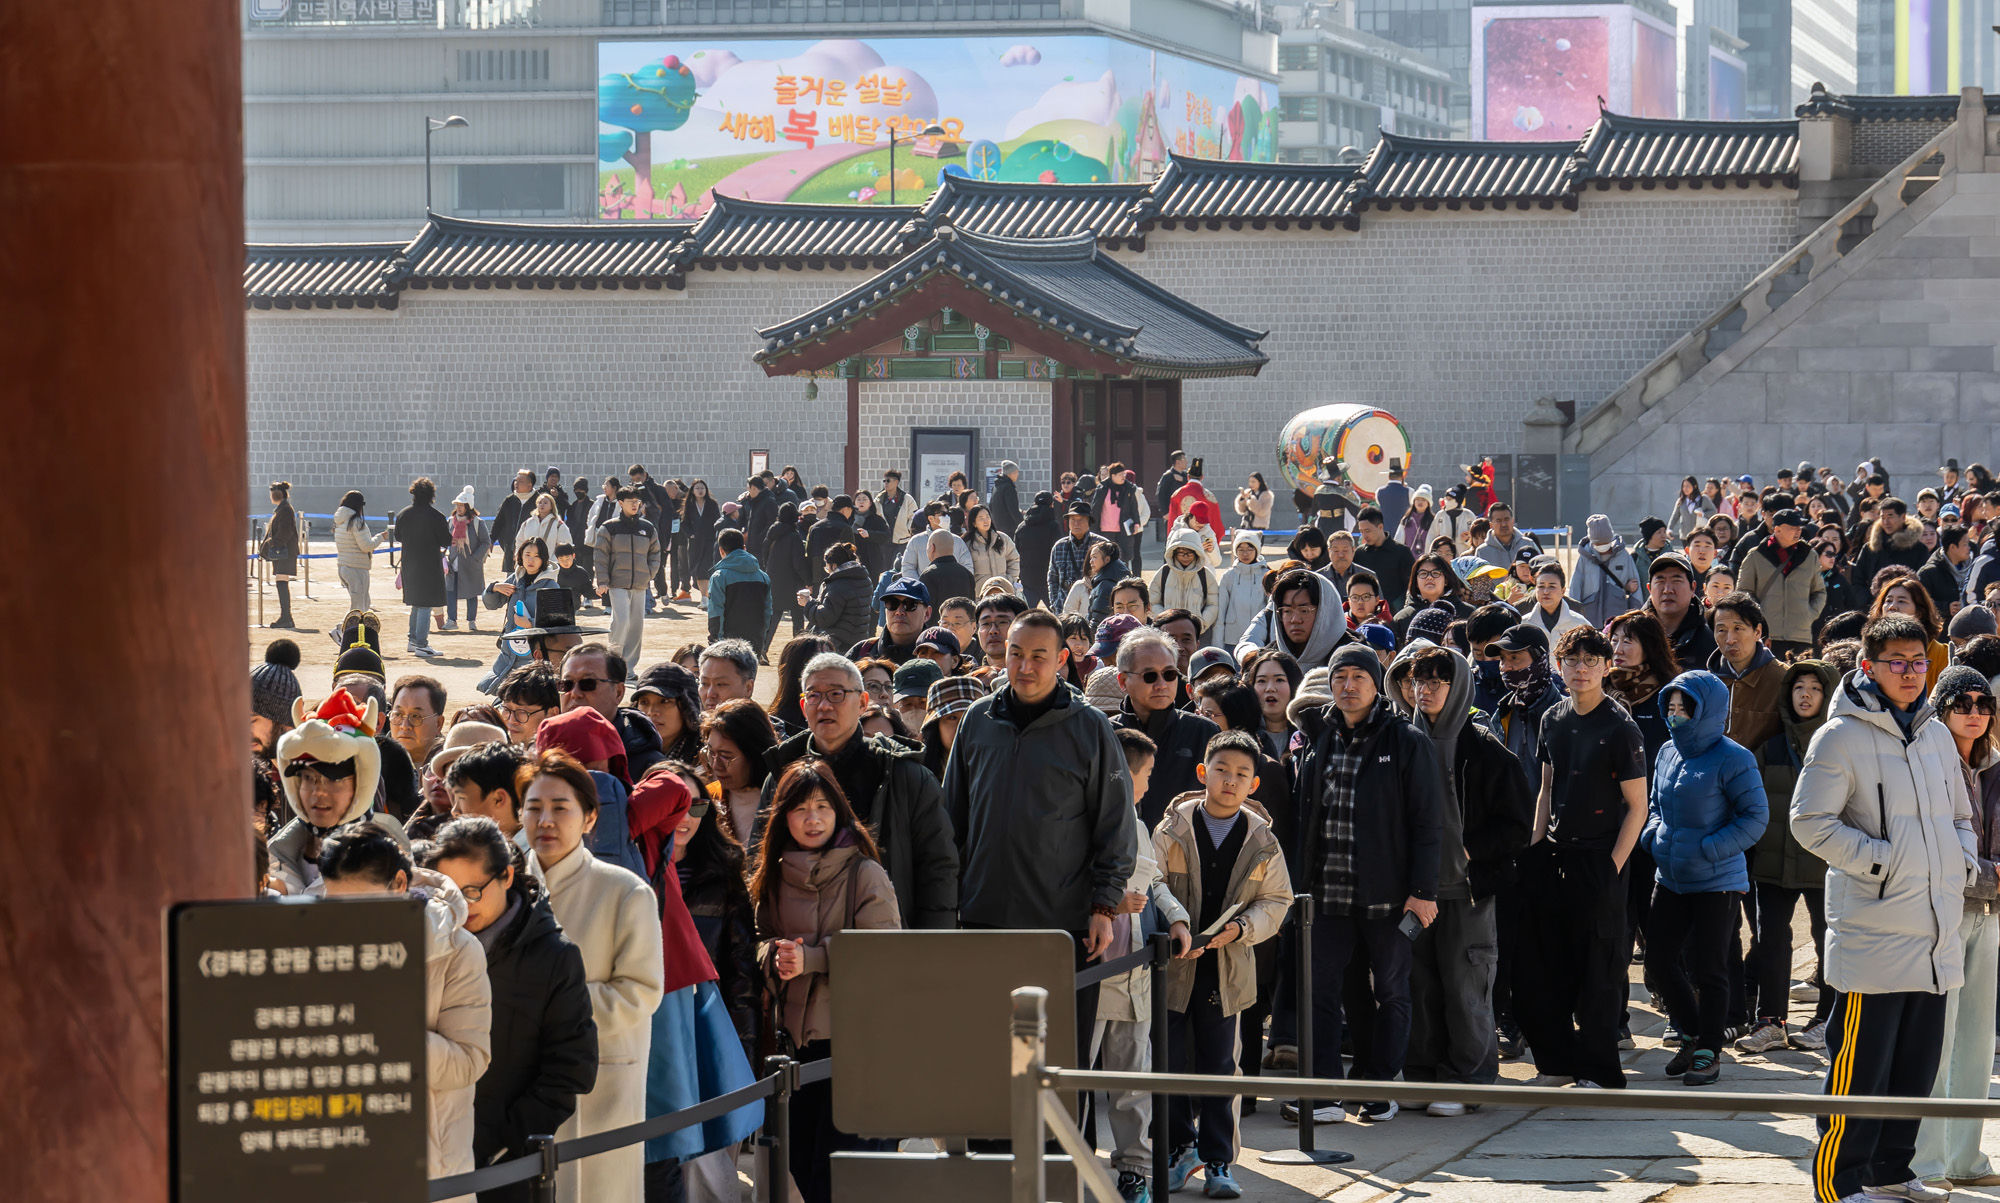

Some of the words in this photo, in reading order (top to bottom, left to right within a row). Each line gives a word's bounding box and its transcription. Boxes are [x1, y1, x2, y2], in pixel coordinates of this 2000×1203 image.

[773, 75, 848, 106] 즐거운
[855, 73, 912, 107] 설날,
[718, 111, 776, 143] 새해
[782, 108, 820, 151] 복
[828, 113, 882, 146] 배달
[884, 113, 967, 147] 왔어요
[272, 946, 311, 974] 관람
[315, 944, 355, 972] 관련
[254, 1006, 301, 1030] 경복궁
[304, 1004, 335, 1027] 관람
[337, 1003, 356, 1024] 시
[279, 1035, 340, 1059] 부정사용
[311, 1065, 343, 1088] 입장
[380, 1061, 413, 1084] 위해
[232, 1100, 249, 1123] 후
[252, 1096, 323, 1121] 재입장이
[327, 1093, 363, 1118] 불가
[366, 1092, 412, 1115] 하오니
[239, 1130, 274, 1154] 양해
[275, 1125, 370, 1151] 부탁드립니다.
